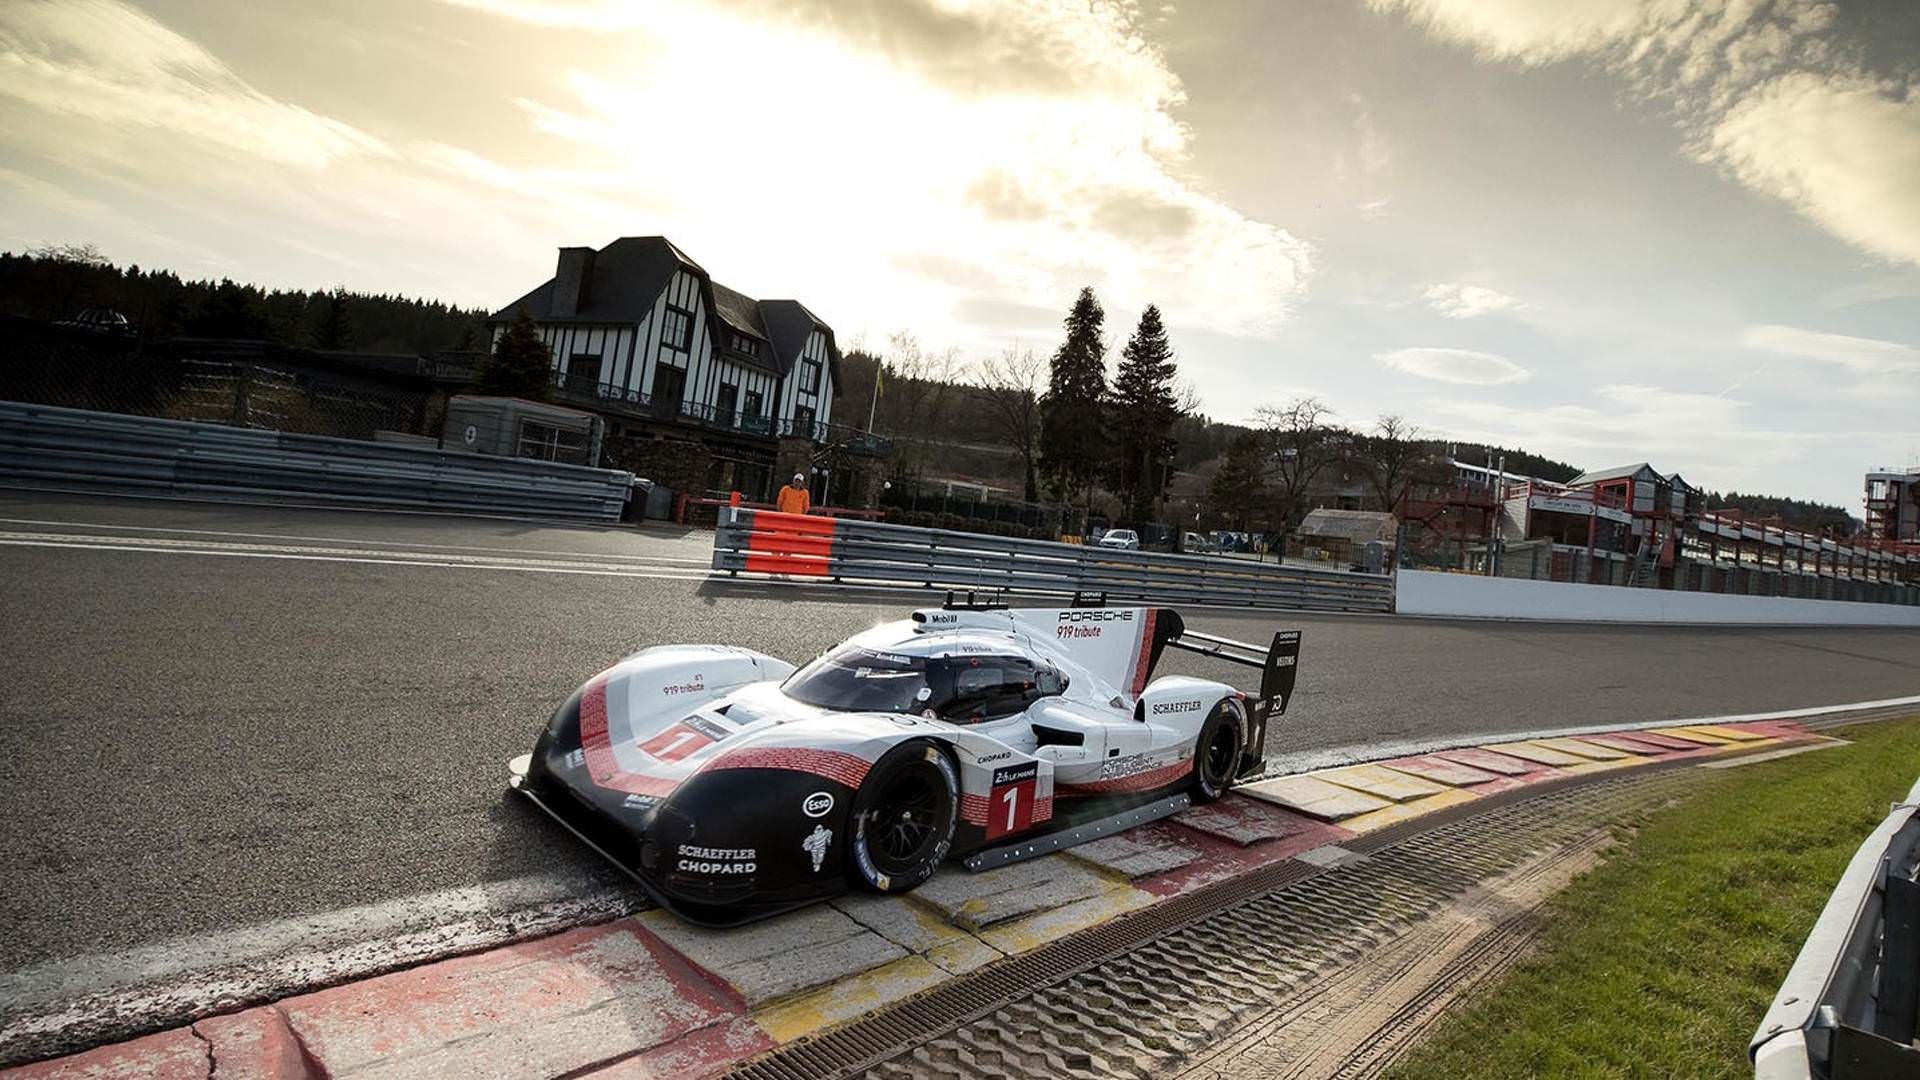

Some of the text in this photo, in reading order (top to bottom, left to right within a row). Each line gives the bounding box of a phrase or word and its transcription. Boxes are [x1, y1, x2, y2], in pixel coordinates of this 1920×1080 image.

[1058, 611, 1134, 622] PORSCHE
[1056, 626, 1101, 639] 919 tribute
[664, 683, 704, 696] 919 tribute
[1152, 701, 1201, 715] SCHAEFFLER
[652, 732, 697, 757] 1
[977, 752, 1012, 764] CHOPARD
[1018, 769, 1035, 779] MANS
[1003, 787, 1018, 831] 1
[678, 844, 756, 859] SCHAEFFLER
[678, 860, 757, 874] CHOPARD
